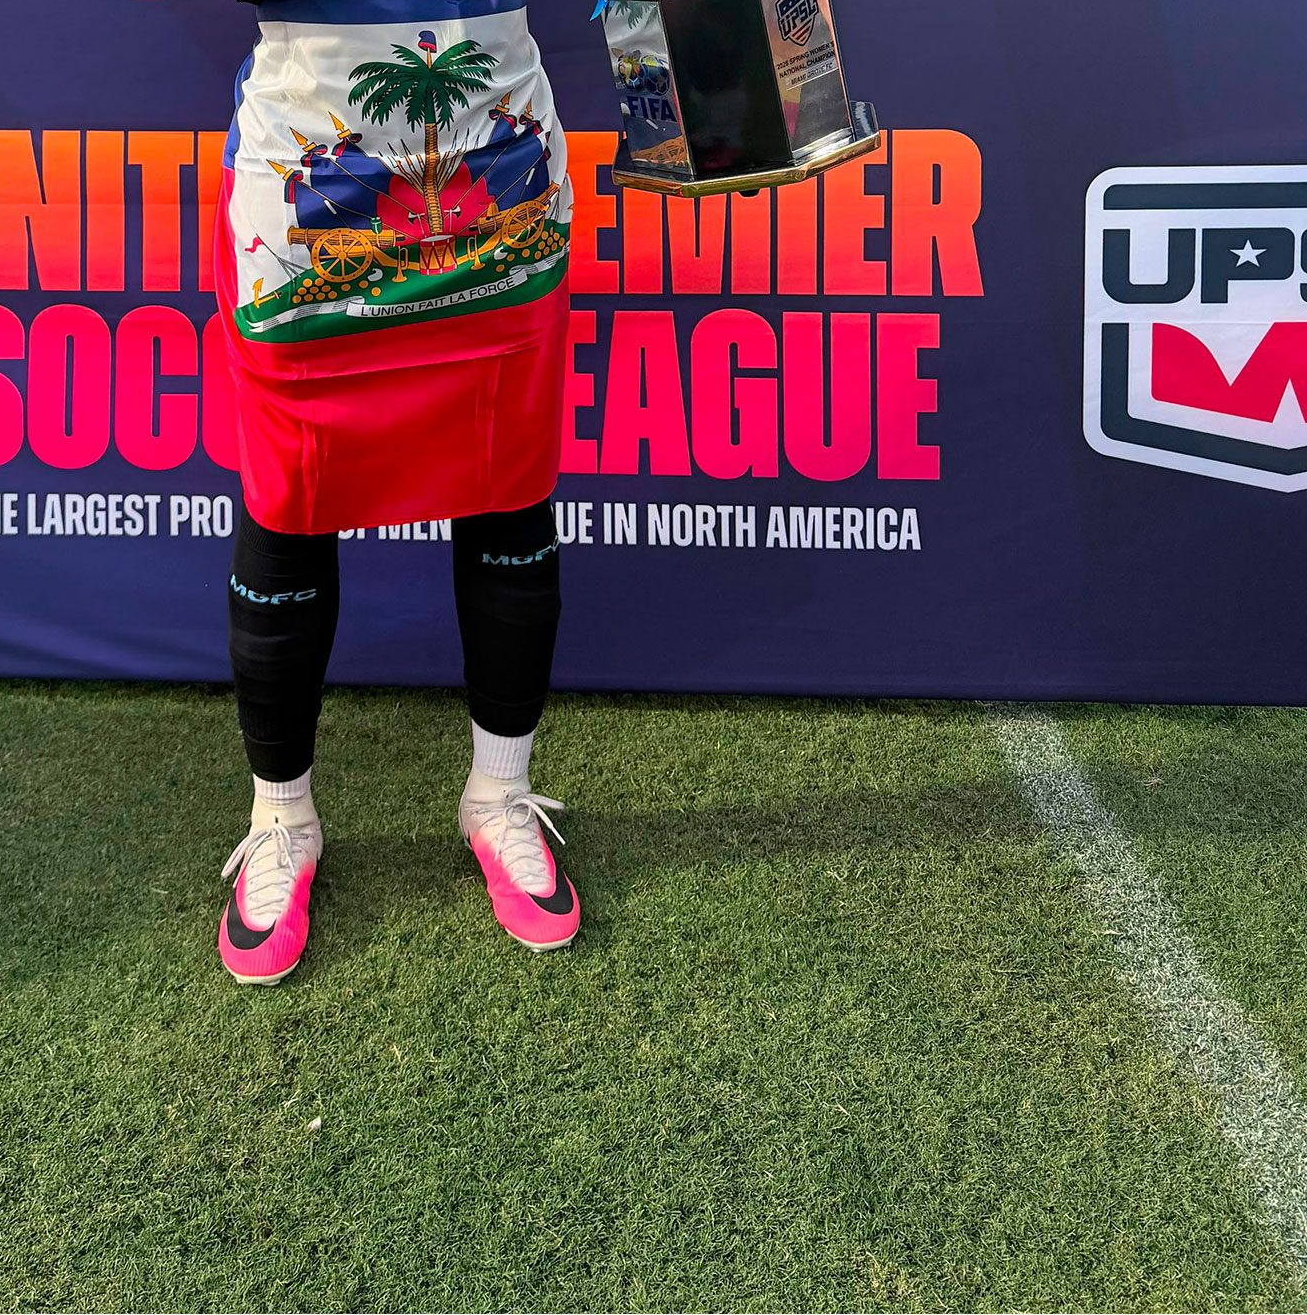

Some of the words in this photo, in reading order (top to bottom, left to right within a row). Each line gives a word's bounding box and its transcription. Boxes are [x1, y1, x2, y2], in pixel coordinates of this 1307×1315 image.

[778, 63, 807, 79] NATIONAL
[627, 95, 678, 122] FIFA
[565, 130, 984, 297] EMIER
[1102, 227, 1307, 305] UP
[361, 304, 415, 317] L'UNION
[418, 297, 447, 311] FAIT
[449, 293, 467, 304] LA
[469, 277, 516, 299] FORCE
[558, 308, 940, 482] EAGUE
[26, 493, 160, 537] LARGEST
[170, 494, 234, 537] PRO
[603, 502, 636, 546] IN
[647, 504, 756, 548] NORTH
[765, 506, 922, 551] AMERICA
